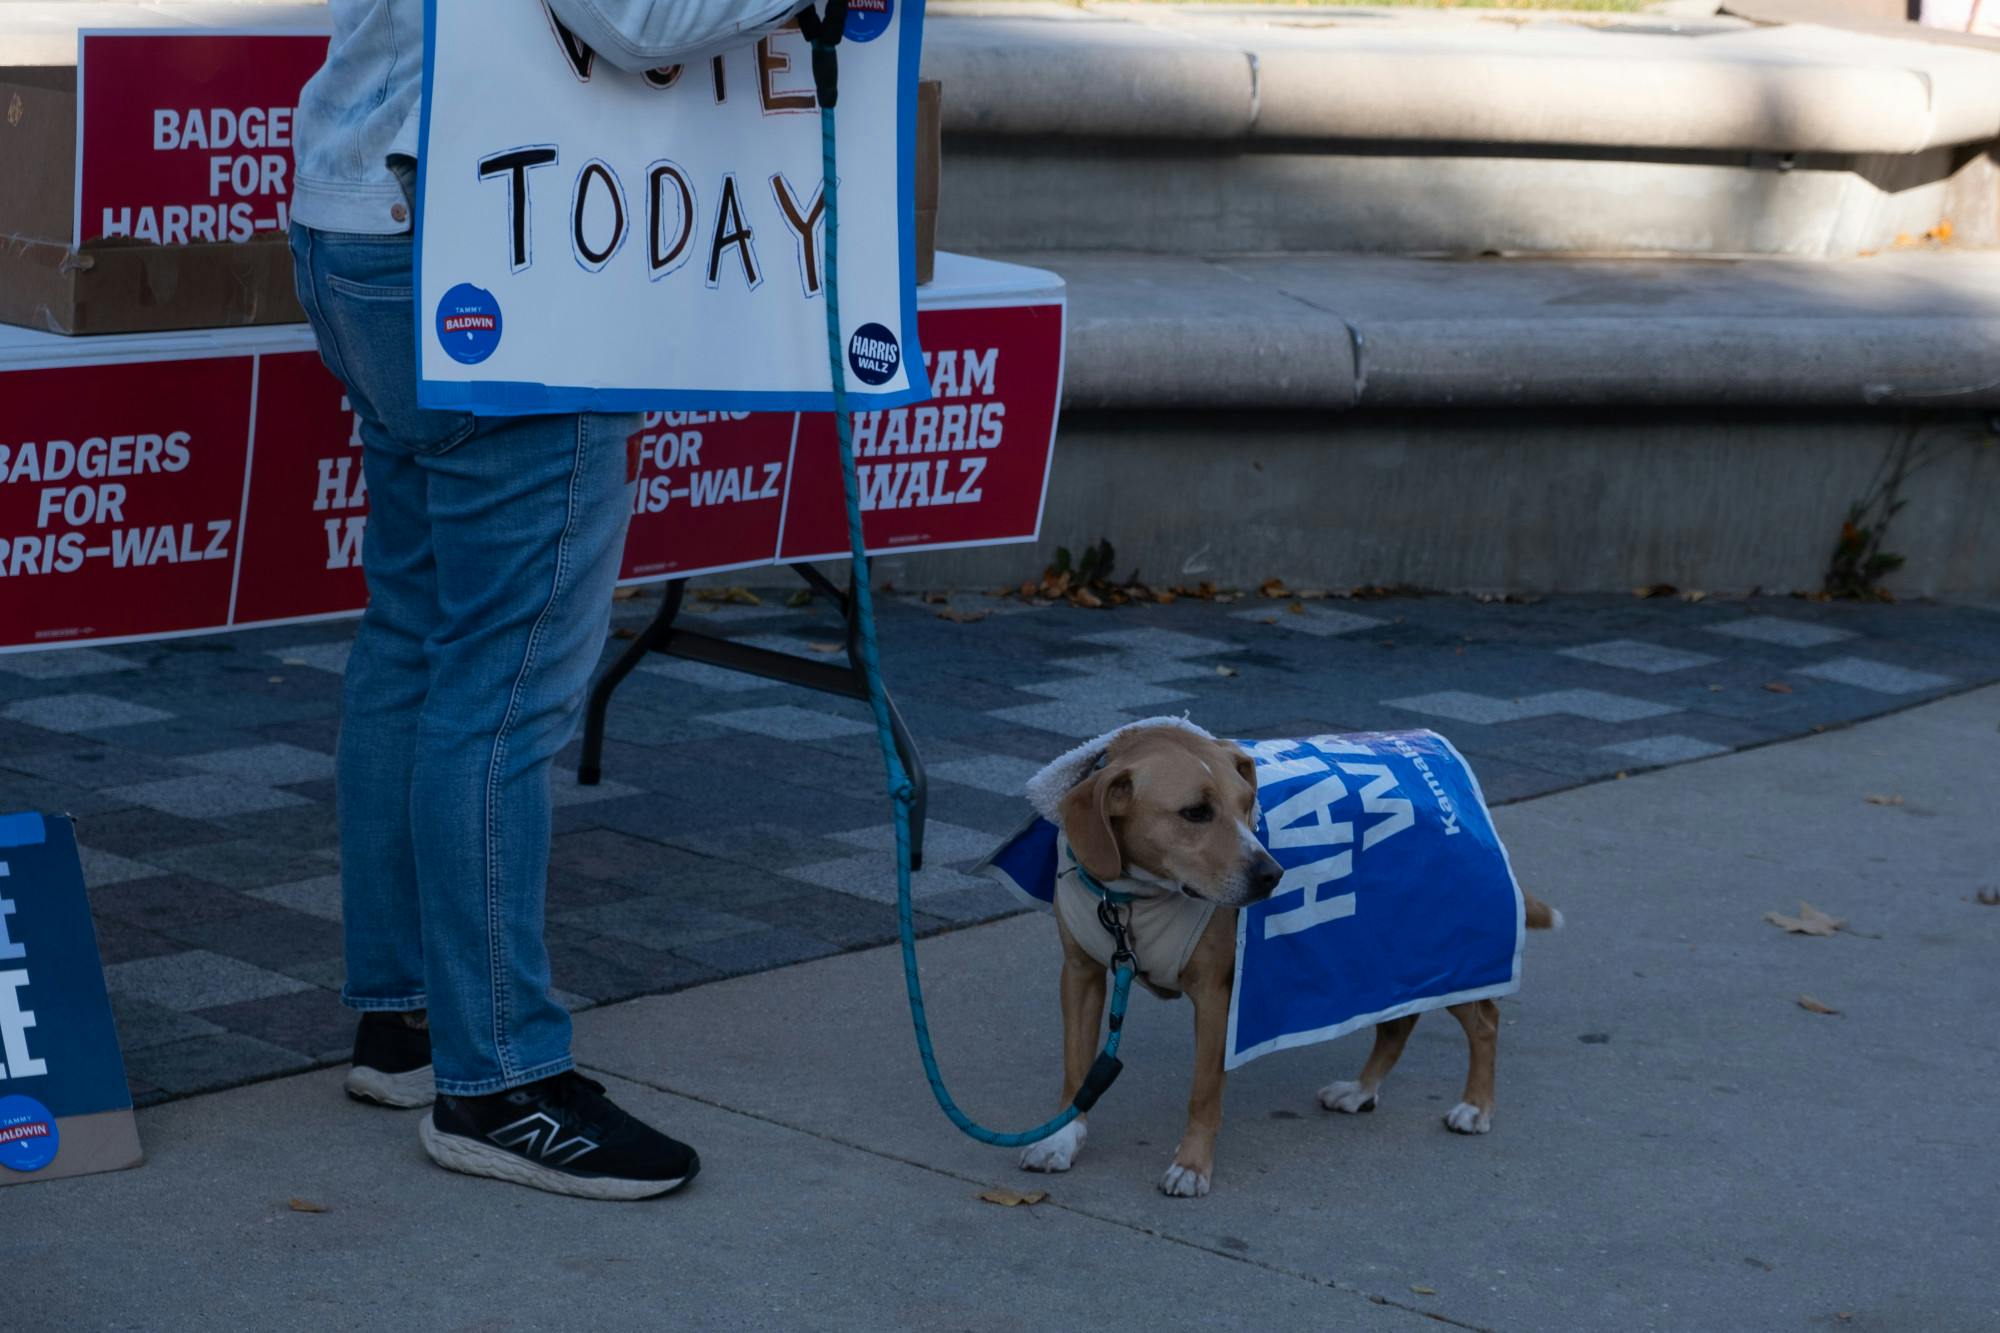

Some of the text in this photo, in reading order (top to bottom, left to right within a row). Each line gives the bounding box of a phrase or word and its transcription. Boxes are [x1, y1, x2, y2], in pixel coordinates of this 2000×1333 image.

[153, 107, 299, 151] BADGE
[209, 154, 288, 197] FOR
[478, 144, 841, 299] TODAY
[446, 317, 494, 330] BALDWIN
[852, 335, 898, 363] HARRIS
[858, 357, 889, 374] WALZ
[639, 430, 703, 471] FOR
[852, 402, 1006, 458] HARRIS
[37, 483, 127, 529] FOR
[632, 461, 783, 516] IS-WALZ
[856, 457, 988, 512] WALZ
[0, 1124, 47, 1142] ALDWIN
[4, 1115, 32, 1126] TAMMY
